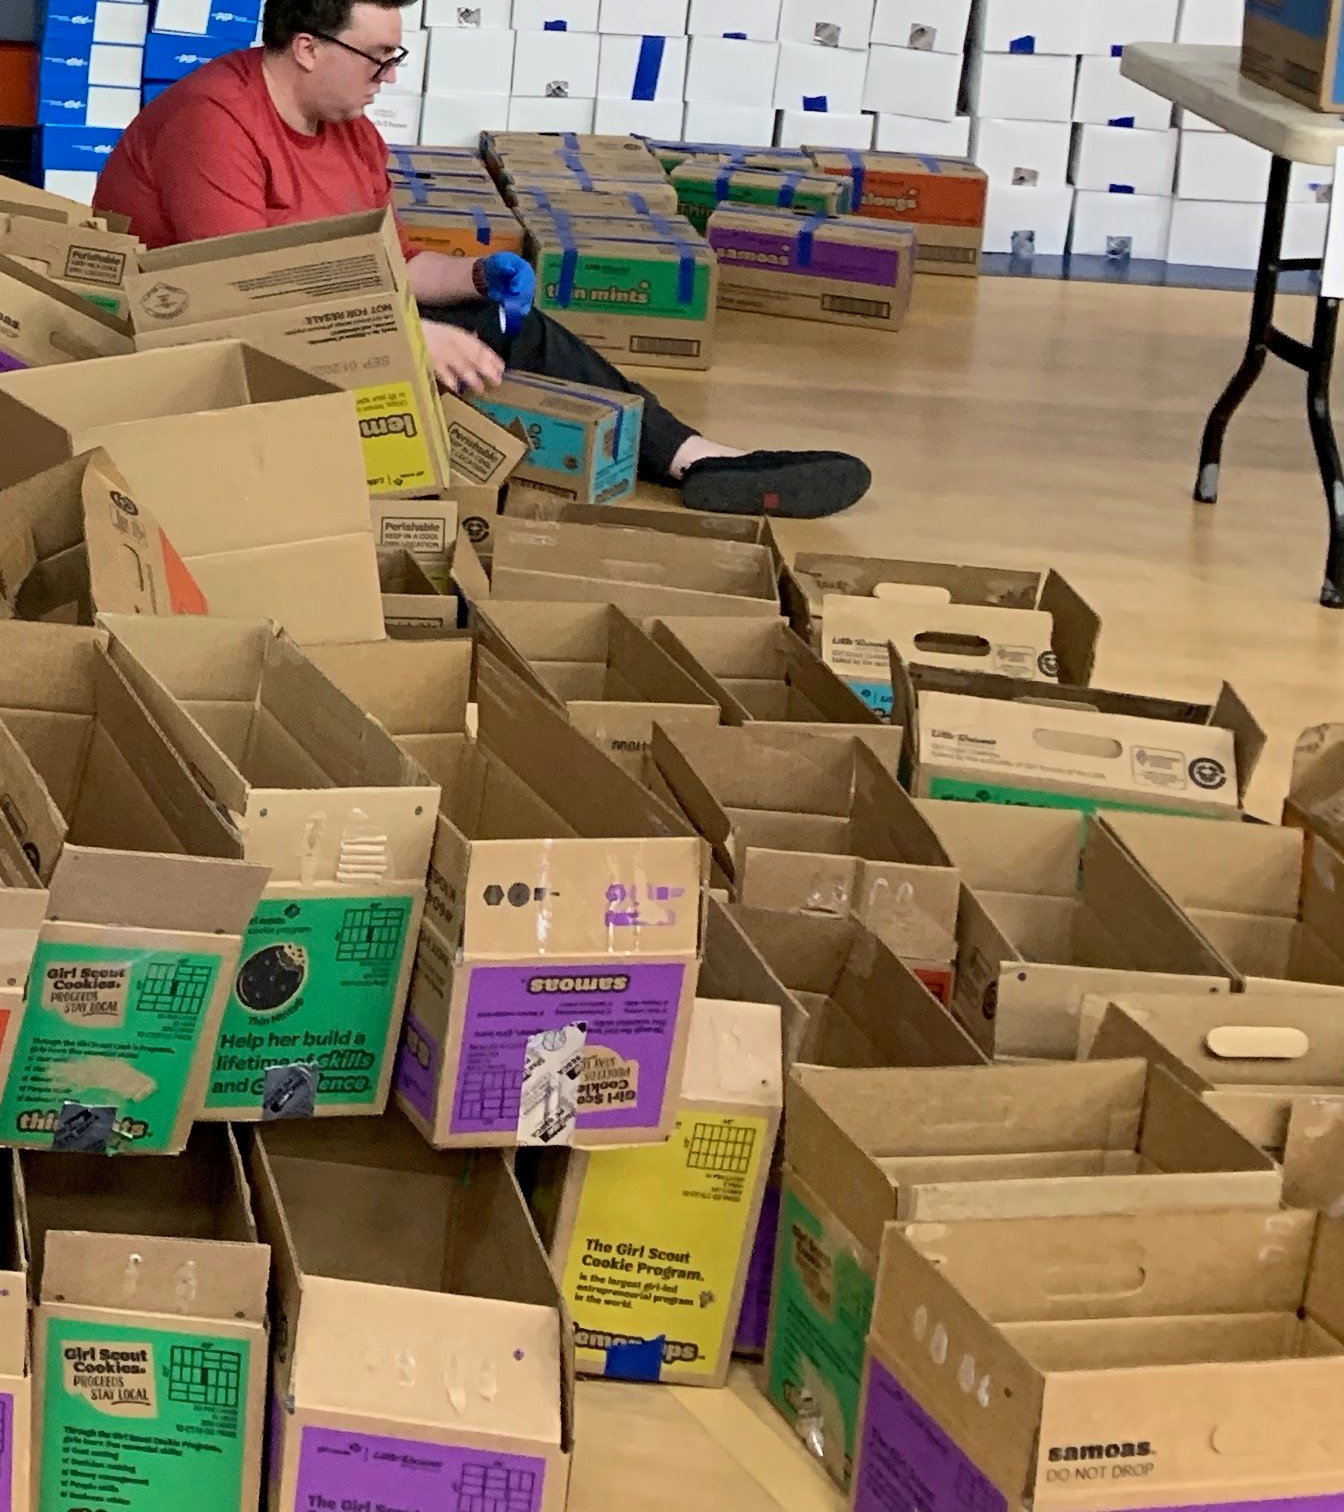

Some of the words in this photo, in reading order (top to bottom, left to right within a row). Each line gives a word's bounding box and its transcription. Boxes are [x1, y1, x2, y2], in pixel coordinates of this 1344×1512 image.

[590, 286, 649, 304] mints
[359, 414, 416, 437] lem
[385, 522, 440, 532] Perishable
[47, 967, 76, 979] Girl
[80, 967, 125, 978] Scout
[528, 974, 630, 994] samoas
[222, 1032, 264, 1050] Help
[268, 1031, 298, 1046] her
[303, 1030, 352, 1045] build
[354, 1034, 366, 1045] a
[316, 1049, 374, 1070] skills
[212, 1077, 248, 1094] and
[586, 1238, 612, 1253] The
[616, 1243, 644, 1258] Girl
[648, 1248, 690, 1263] Scout
[582, 1254, 633, 1271] Cookie
[590, 1275, 605, 1283] the
[608, 1277, 641, 1289] largest
[574, 1293, 584, 1301] in
[586, 1295, 601, 1304] the
[653, 1295, 693, 1305] program
[64, 1347, 94, 1360] Girl
[100, 1349, 147, 1362] Scout
[1046, 1468, 1069, 1482] DO
[1075, 1466, 1106, 1481] NOT
[1112, 1462, 1153, 1479] DROP
